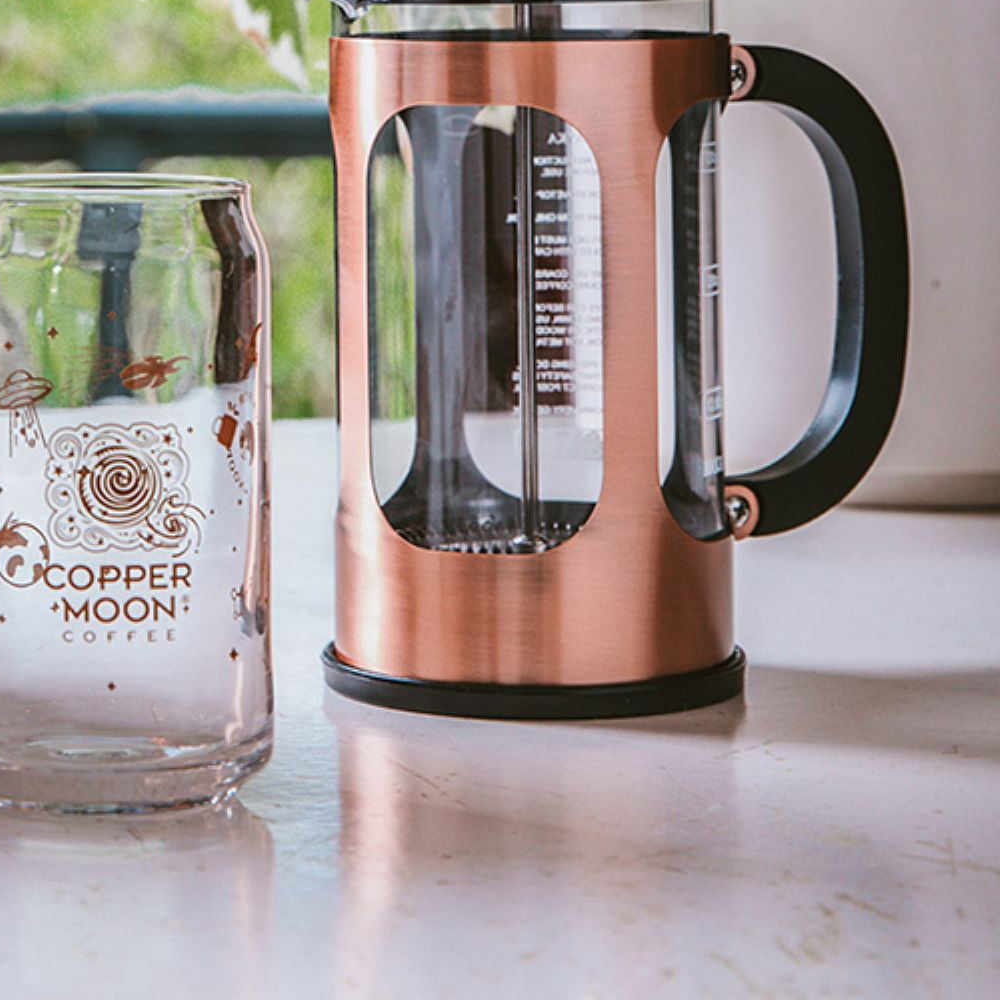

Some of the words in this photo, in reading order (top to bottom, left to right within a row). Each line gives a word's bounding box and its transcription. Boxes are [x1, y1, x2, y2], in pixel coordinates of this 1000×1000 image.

[43, 562, 192, 590] COPPER
[61, 595, 176, 623] MOON
[62, 629, 177, 643] COFFEE
